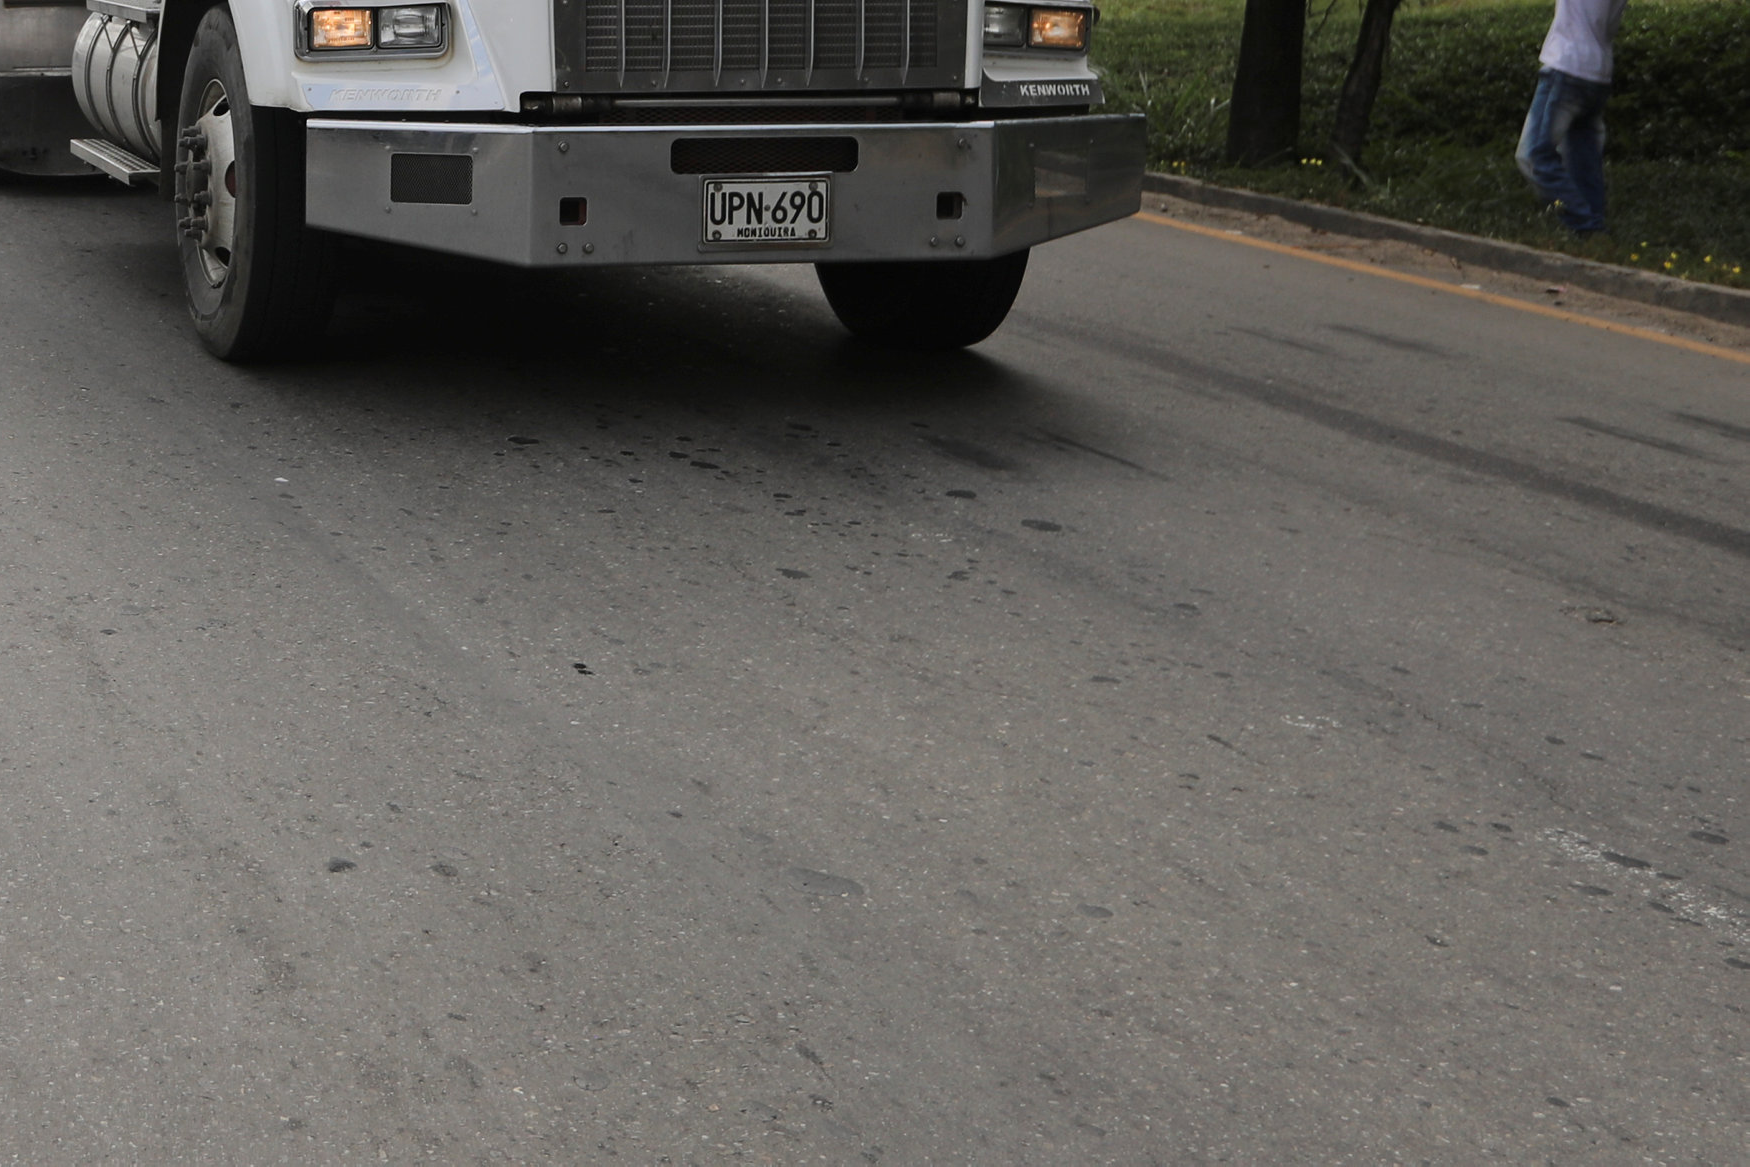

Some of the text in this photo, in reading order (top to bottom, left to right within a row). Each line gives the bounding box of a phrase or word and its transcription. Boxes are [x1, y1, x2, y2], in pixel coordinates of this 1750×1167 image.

[329, 88, 443, 103] KENWORTH
[1020, 83, 1091, 97] KENWORTH
[737, 226, 796, 238] MONIQUIRA
